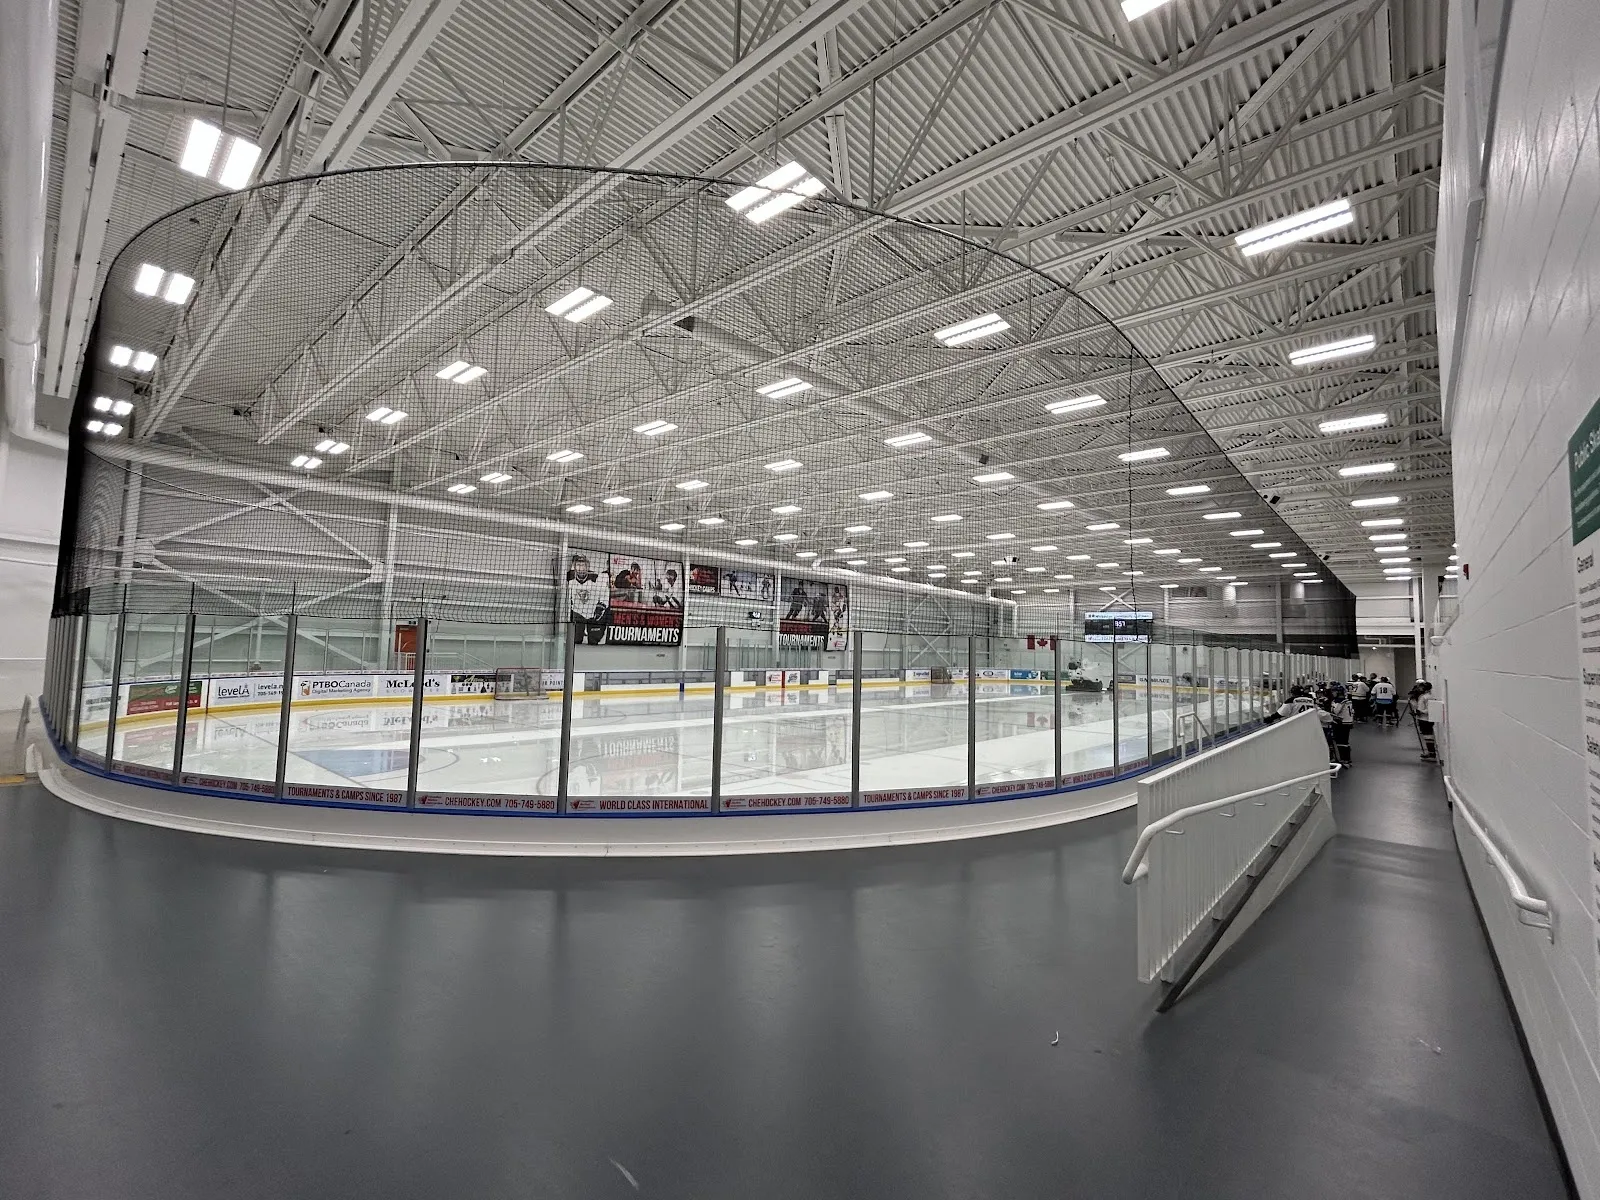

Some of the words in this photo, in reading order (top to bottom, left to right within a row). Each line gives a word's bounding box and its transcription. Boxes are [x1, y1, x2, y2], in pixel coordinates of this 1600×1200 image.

[608, 625, 680, 643] TOURNAMENTS
[312, 679, 372, 689] PTBOCanada
[386, 678, 440, 688] McLd's
[287, 786, 334, 799] TOURNAMENTS
[335, 790, 340, 799] &
[341, 790, 364, 800] CAMPS
[364, 791, 384, 802] SINCE
[386, 793, 403, 803] 1987
[863, 792, 907, 803] TOURNAMENTS
[907, 791, 912, 801] &
[912, 790, 933, 800] CAMPS
[933, 789, 949, 799] SINCE
[951, 788, 965, 798] 1987
[445, 796, 501, 808] CHEHOCKEY.COM
[505, 799, 555, 810] 705-749-5880
[600, 799, 626, 810] WORLD
[627, 799, 651, 810] CLASS
[652, 799, 709, 810] INTERNATIONAL
[748, 797, 801, 808] CHEHOCKEY.COM
[804, 795, 850, 806] 705-749-5880
